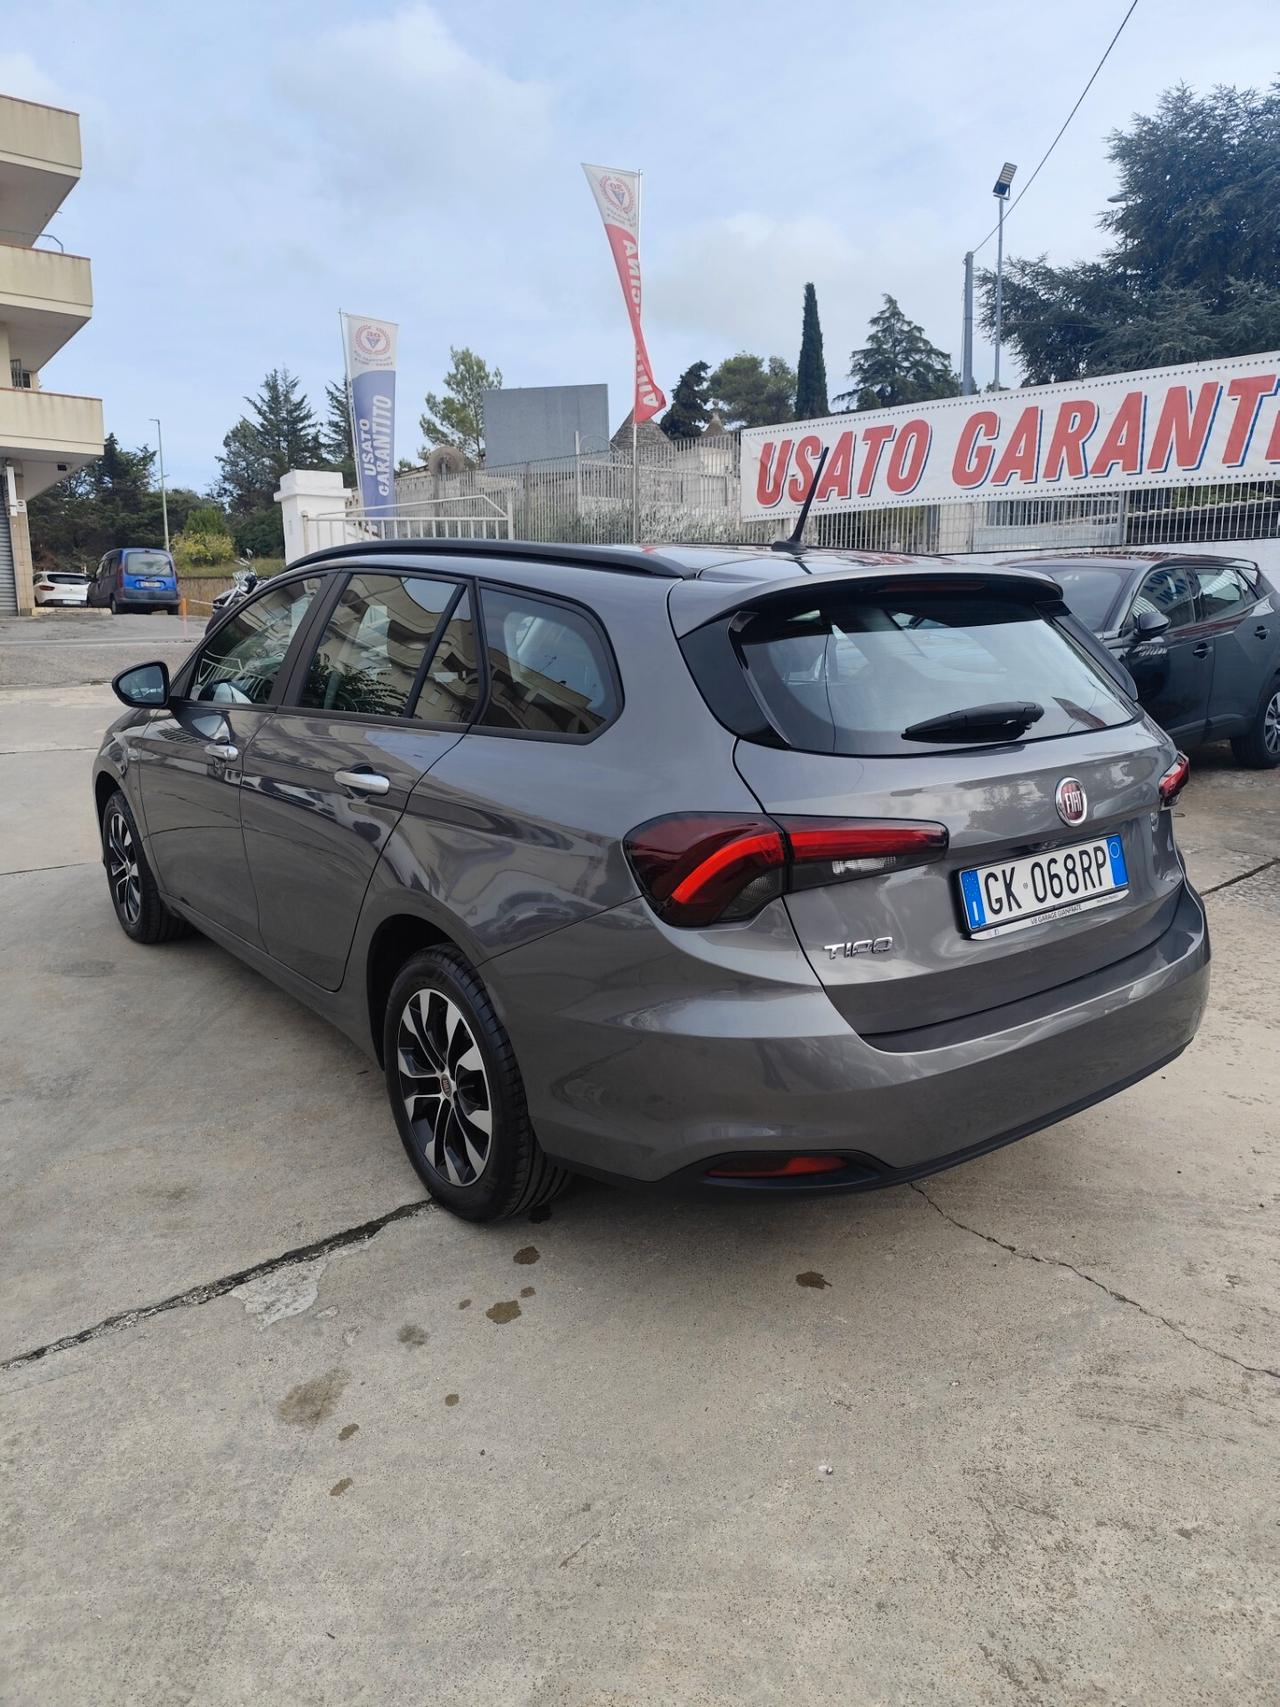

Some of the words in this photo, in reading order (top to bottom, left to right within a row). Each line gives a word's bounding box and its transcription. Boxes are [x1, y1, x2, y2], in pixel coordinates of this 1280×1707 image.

[360, 418, 377, 477] USATO
[372, 394, 392, 497] GARANTITO
[756, 418, 933, 509] USATO
[951, 374, 1280, 490] GARANT
[1064, 790, 1083, 814] FIAT
[984, 866, 1023, 915] GK
[1030, 845, 1107, 904] 068RP
[823, 936, 894, 960] TIPO
